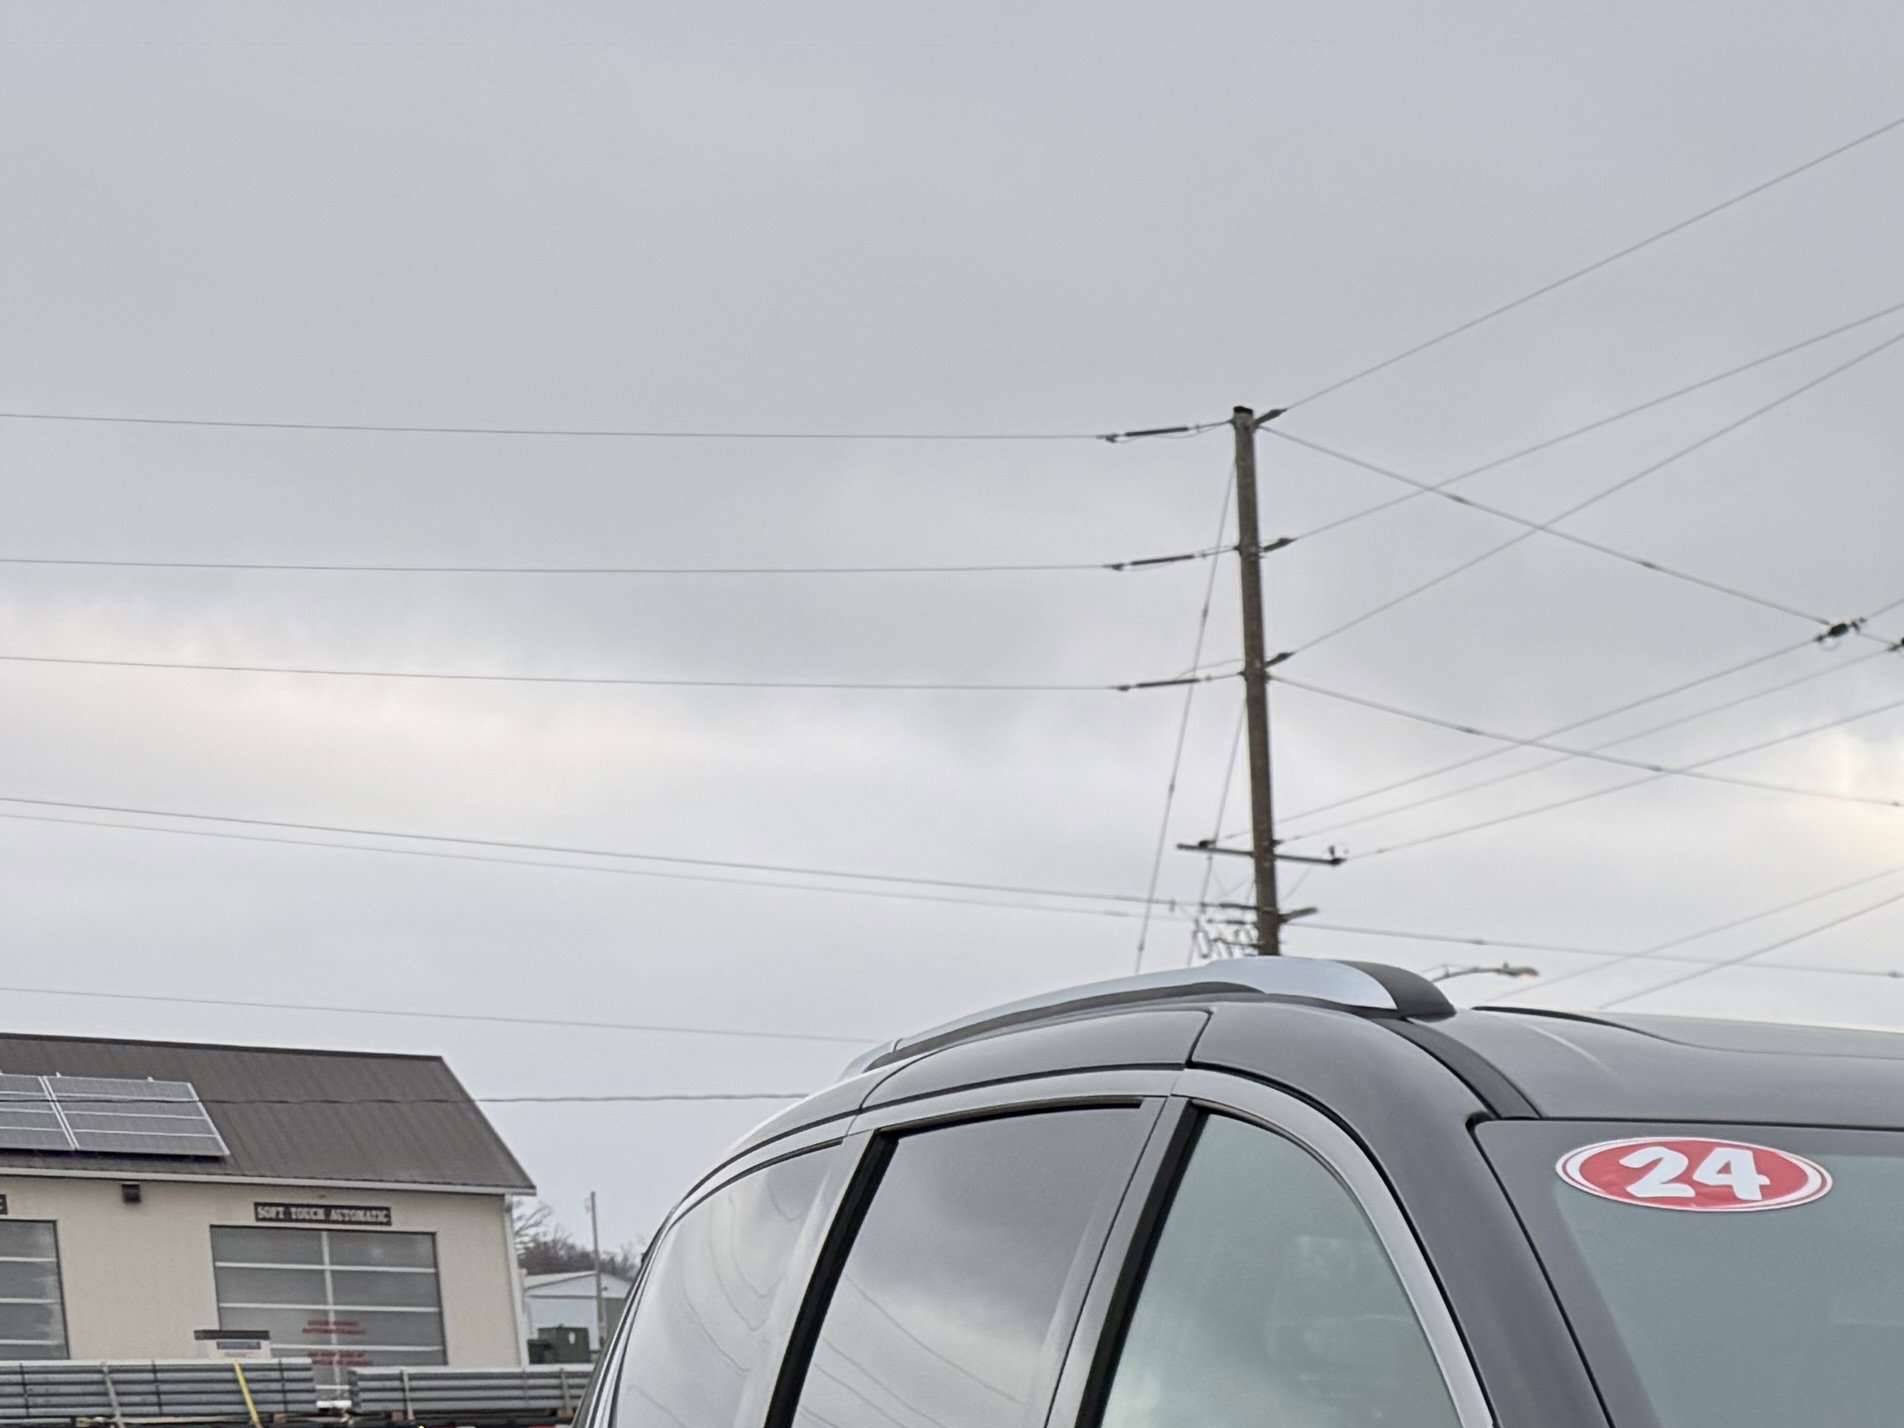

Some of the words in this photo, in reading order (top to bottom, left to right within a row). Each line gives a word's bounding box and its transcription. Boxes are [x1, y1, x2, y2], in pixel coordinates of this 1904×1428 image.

[1618, 1145, 1771, 1201] 24
[256, 1205, 286, 1219] SOFT
[328, 1208, 390, 1223] AUTOMATIC
